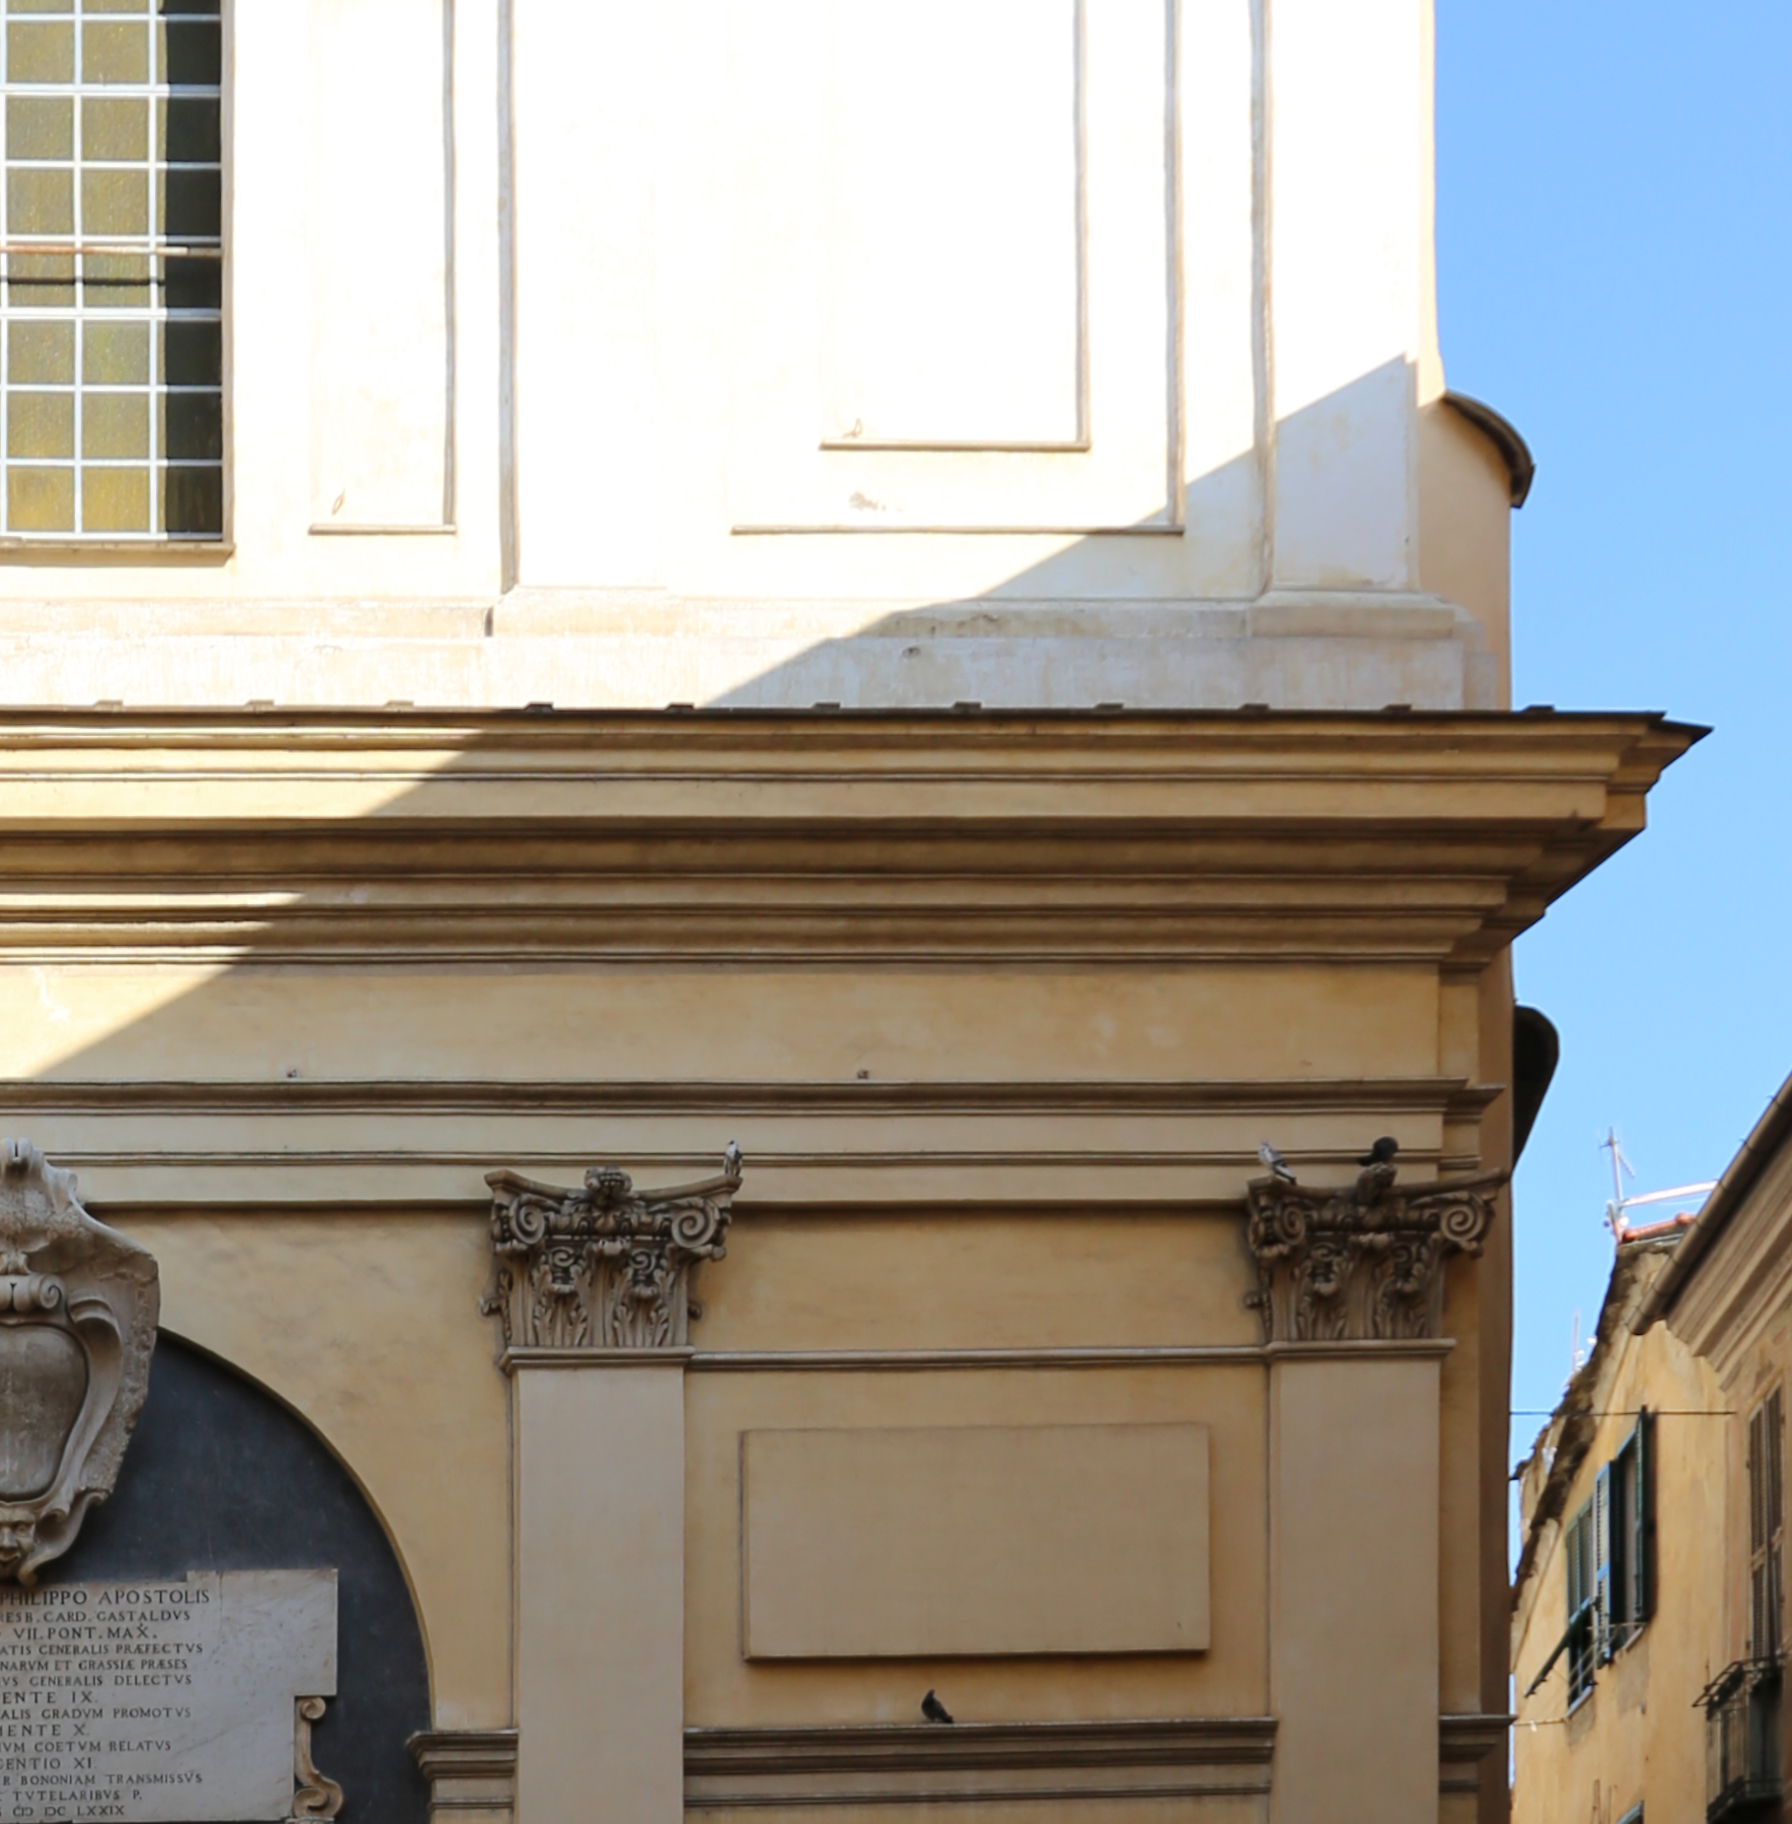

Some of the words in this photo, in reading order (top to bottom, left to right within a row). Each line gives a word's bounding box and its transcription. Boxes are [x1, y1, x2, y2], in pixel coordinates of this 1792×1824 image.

[0, 1590, 87, 1605] PHILIPPO
[99, 1590, 209, 1604] APOSTOLIS
[55, 1660, 72, 1670] ET
[115, 1675, 191, 1685] DELECTVS
[113, 1707, 191, 1718] PROMOTVS
[35, 1741, 101, 1752] COETVM
[109, 1740, 170, 1751] RELATVS
[21, 1775, 95, 1785] BONONIAM
[107, 1772, 203, 1784] TRANSMISSVS
[13, 1790, 120, 1801] TVTELARIBVS
[77, 1805, 125, 1815] LXXIX
